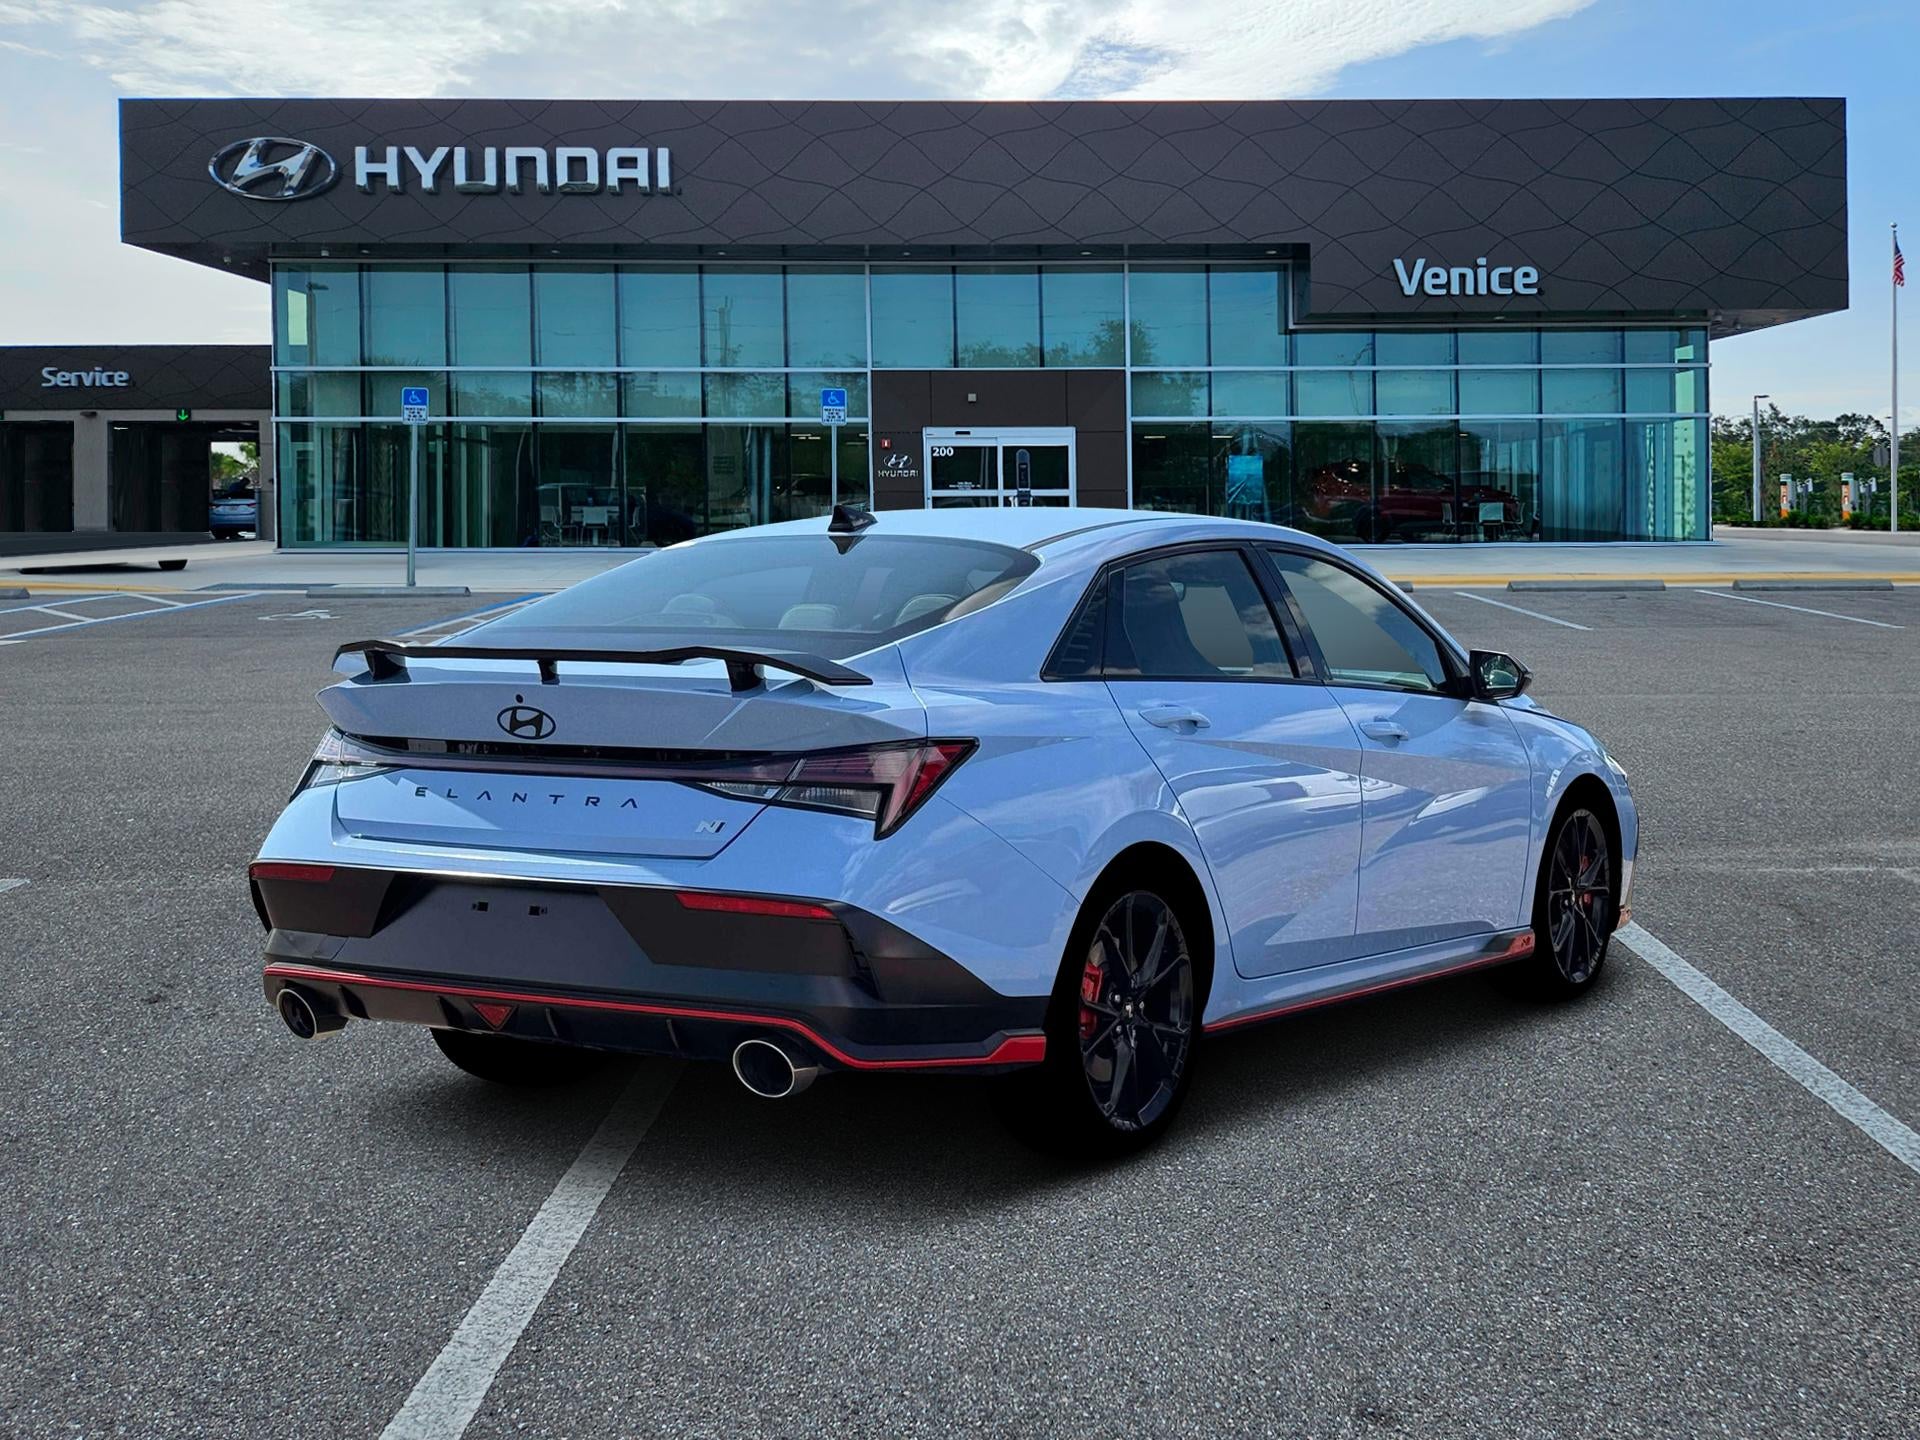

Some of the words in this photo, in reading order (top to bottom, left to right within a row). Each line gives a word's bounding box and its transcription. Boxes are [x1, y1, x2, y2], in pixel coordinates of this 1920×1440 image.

[355, 146, 671, 194] HYUNDAI
[1393, 257, 1538, 296] Venice
[41, 366, 129, 387] Service
[932, 447, 954, 457] 200
[878, 469, 919, 478] HYUNDAI
[414, 786, 638, 809] ELANTRA
